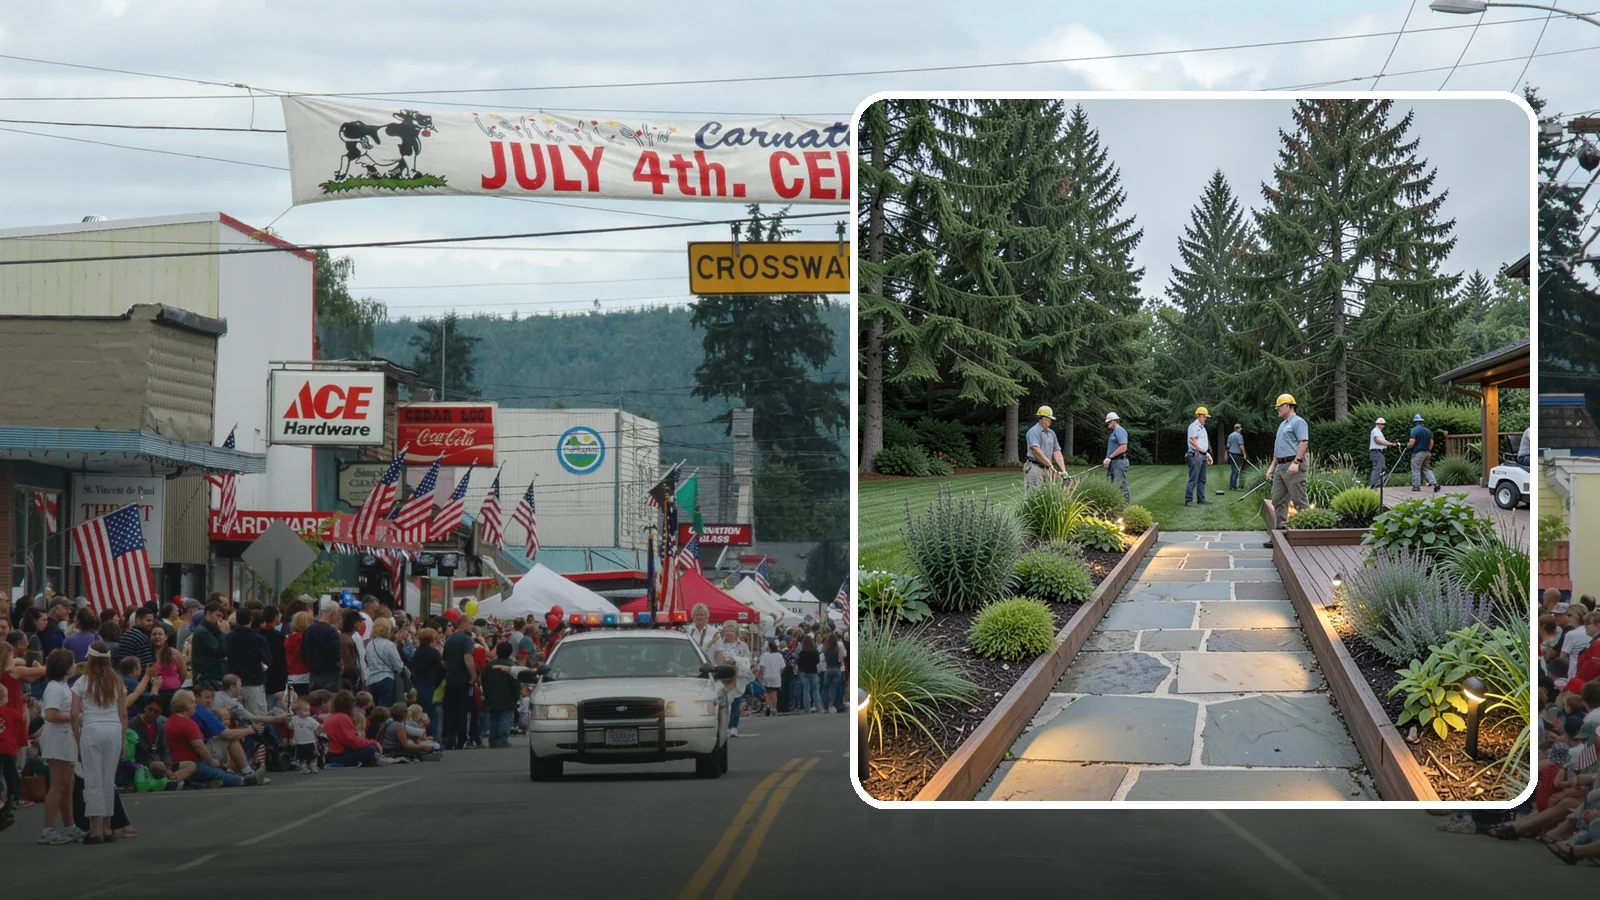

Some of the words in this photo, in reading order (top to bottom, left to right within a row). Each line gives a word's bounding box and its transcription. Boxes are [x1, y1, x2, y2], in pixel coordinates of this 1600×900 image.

[481, 141, 604, 192] JULY
[632, 150, 746, 198] 4th.
[697, 254, 850, 280] CROSSWA
[283, 380, 373, 420] ACE
[406, 409, 452, 422] CEDAR
[283, 421, 370, 436] Hardware
[416, 428, 477, 447] Coca-Cola
[353, 467, 386, 480] Simpl
[95, 485, 124, 495] Vincent
[126, 486, 135, 494] de
[137, 485, 155, 495] Paul
[212, 515, 331, 535] HARDARE
[688, 526, 742, 535] CRNATION
[699, 535, 730, 543] GLASS
